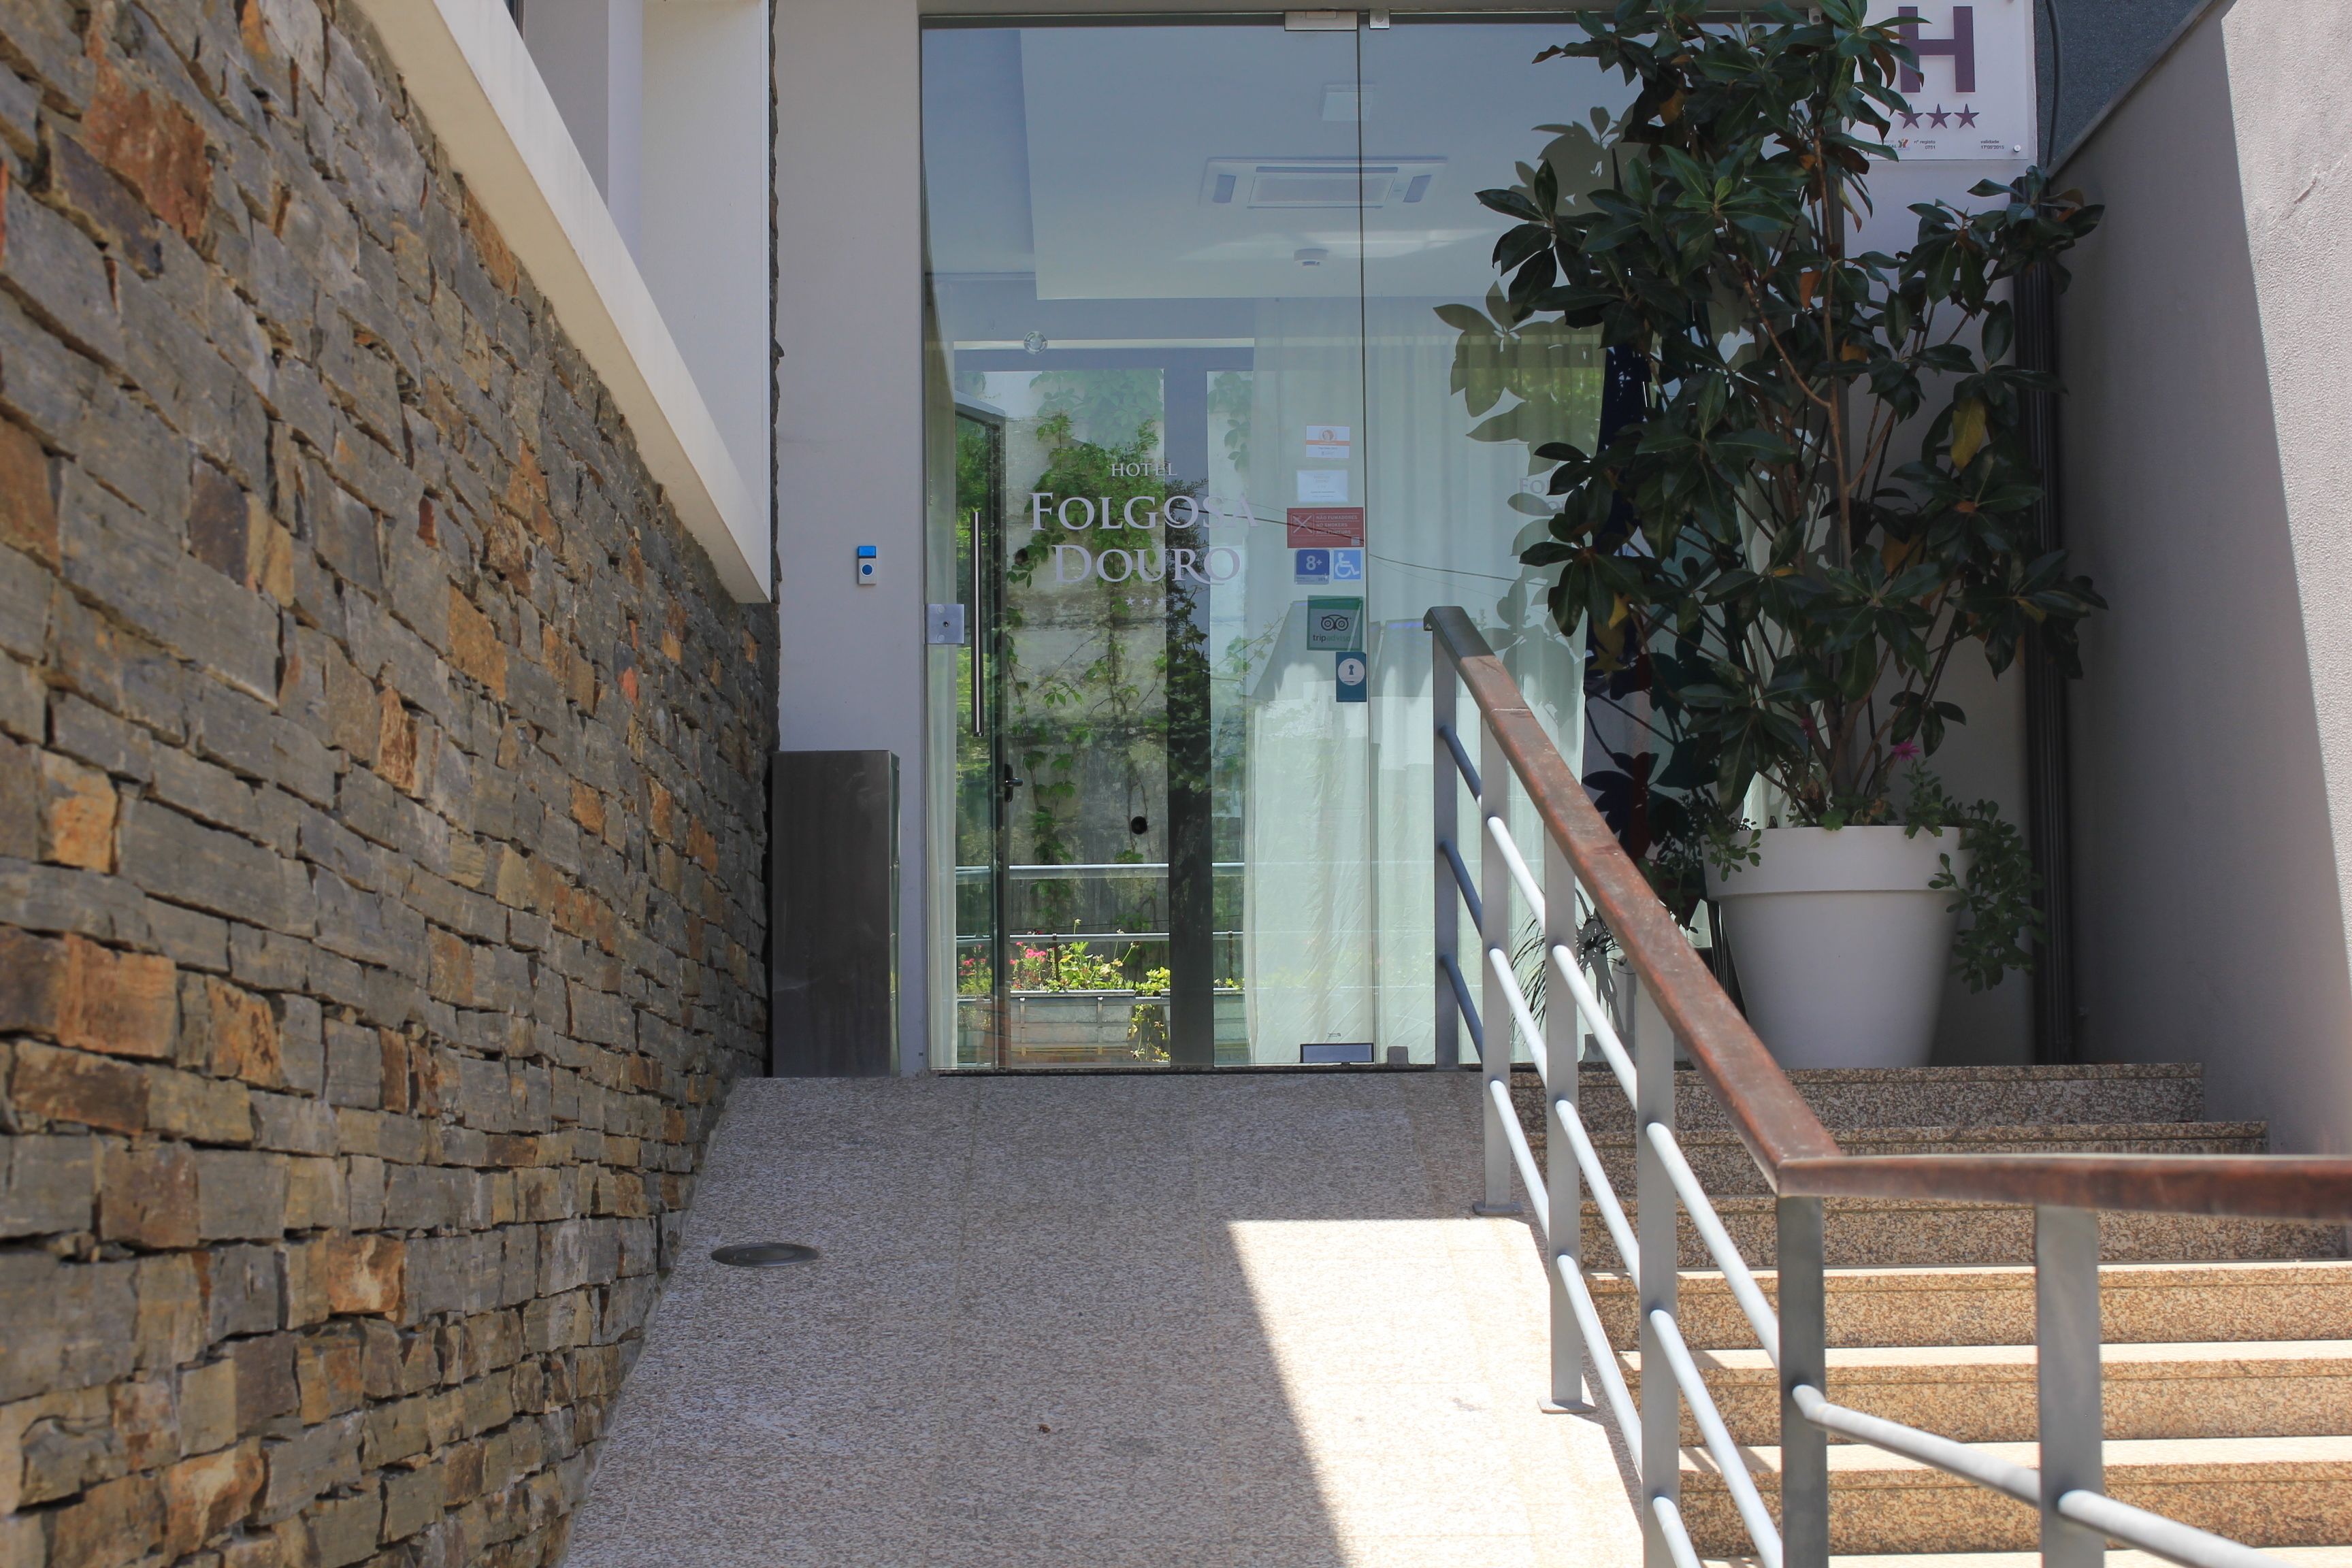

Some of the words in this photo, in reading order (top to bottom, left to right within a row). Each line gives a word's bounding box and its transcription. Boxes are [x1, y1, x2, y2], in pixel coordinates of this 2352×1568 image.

[1898, 6, 1975, 93] H
[1111, 463, 1177, 476] HOTEL
[1029, 492, 1259, 531] FOLGOSA
[1053, 544, 1241, 586] DOURO
